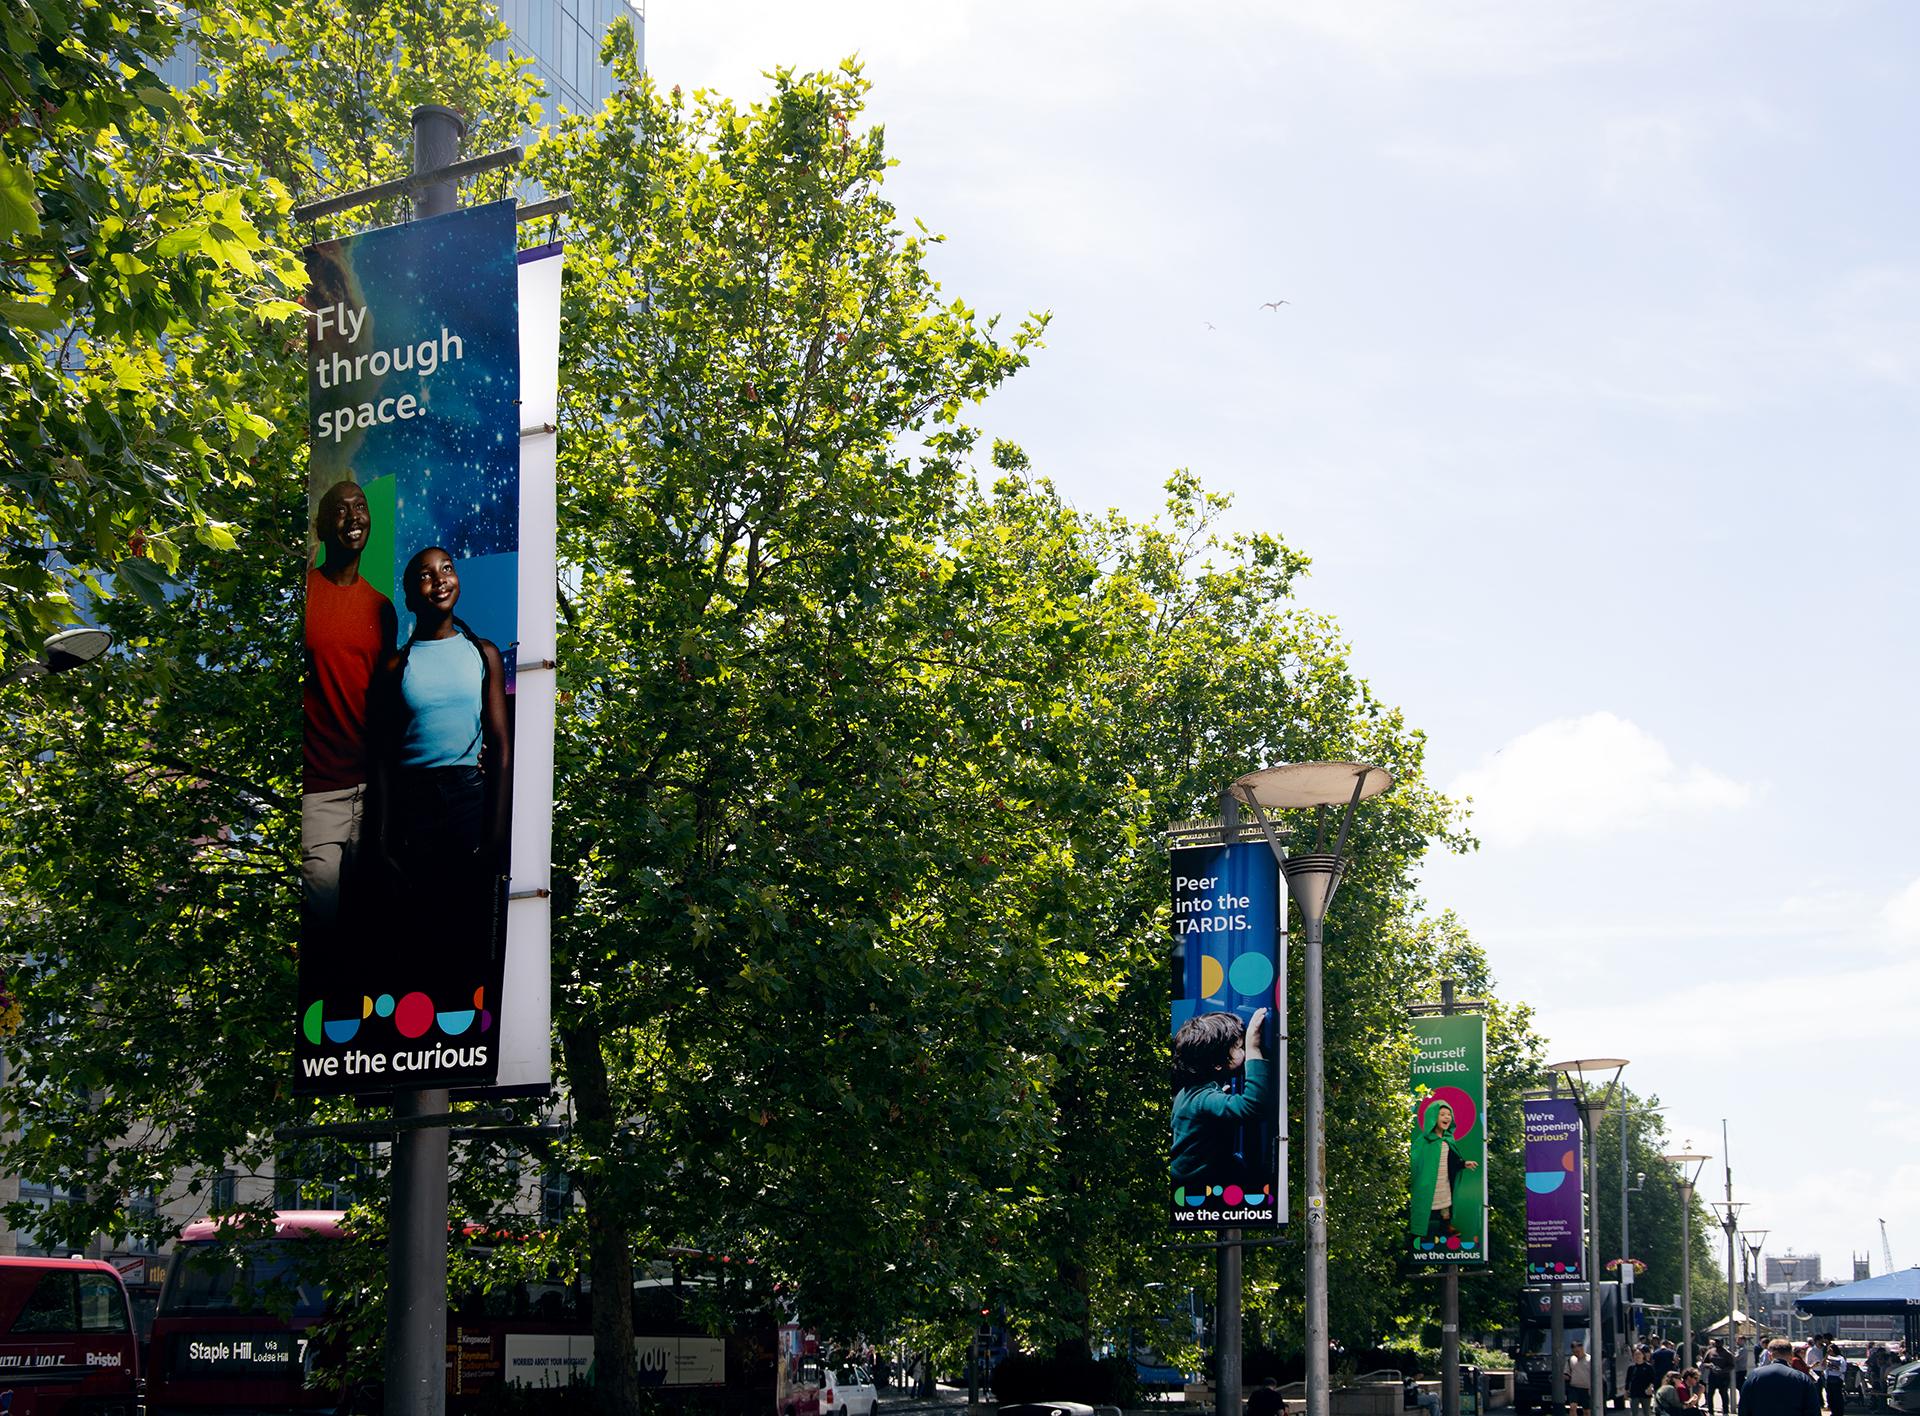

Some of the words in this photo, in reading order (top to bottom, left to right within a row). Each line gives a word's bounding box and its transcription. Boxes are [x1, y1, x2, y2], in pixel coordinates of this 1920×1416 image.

[316, 302, 367, 343] Fly
[316, 328, 463, 389] through
[317, 393, 426, 443] space.
[1176, 877, 1218, 891] Peer
[1176, 898, 1212, 913] into
[1218, 894, 1250, 910] the
[1176, 915, 1252, 935] TARDIS.
[302, 1056, 338, 1077] we
[344, 1050, 386, 1075] the
[392, 1042, 487, 1072] curious
[1413, 1061, 1469, 1074] invisible.
[1526, 1112, 1555, 1122] We're
[1526, 1121, 1579, 1132] reopening!
[1526, 1132, 1569, 1142] Curious?
[1175, 1211, 1194, 1221] we
[1197, 1209, 1220, 1221] the
[1222, 1207, 1272, 1220] curious
[1413, 1252, 1427, 1260] we
[1428, 1251, 1444, 1259] the
[1446, 1251, 1480, 1259] curious
[1539, 1295, 1583, 1305] GRT
[462, 1335, 491, 1344] Kingswood
[190, 1342, 229, 1364] Staple
[233, 1342, 252, 1360] Hill
[277, 1352, 288, 1362] Hill
[297, 1339, 308, 1363] 7
[86, 1352, 121, 1366] Bristol
[534, 1358, 549, 1366] ABOUT
[550, 1358, 562, 1366] YOUR
